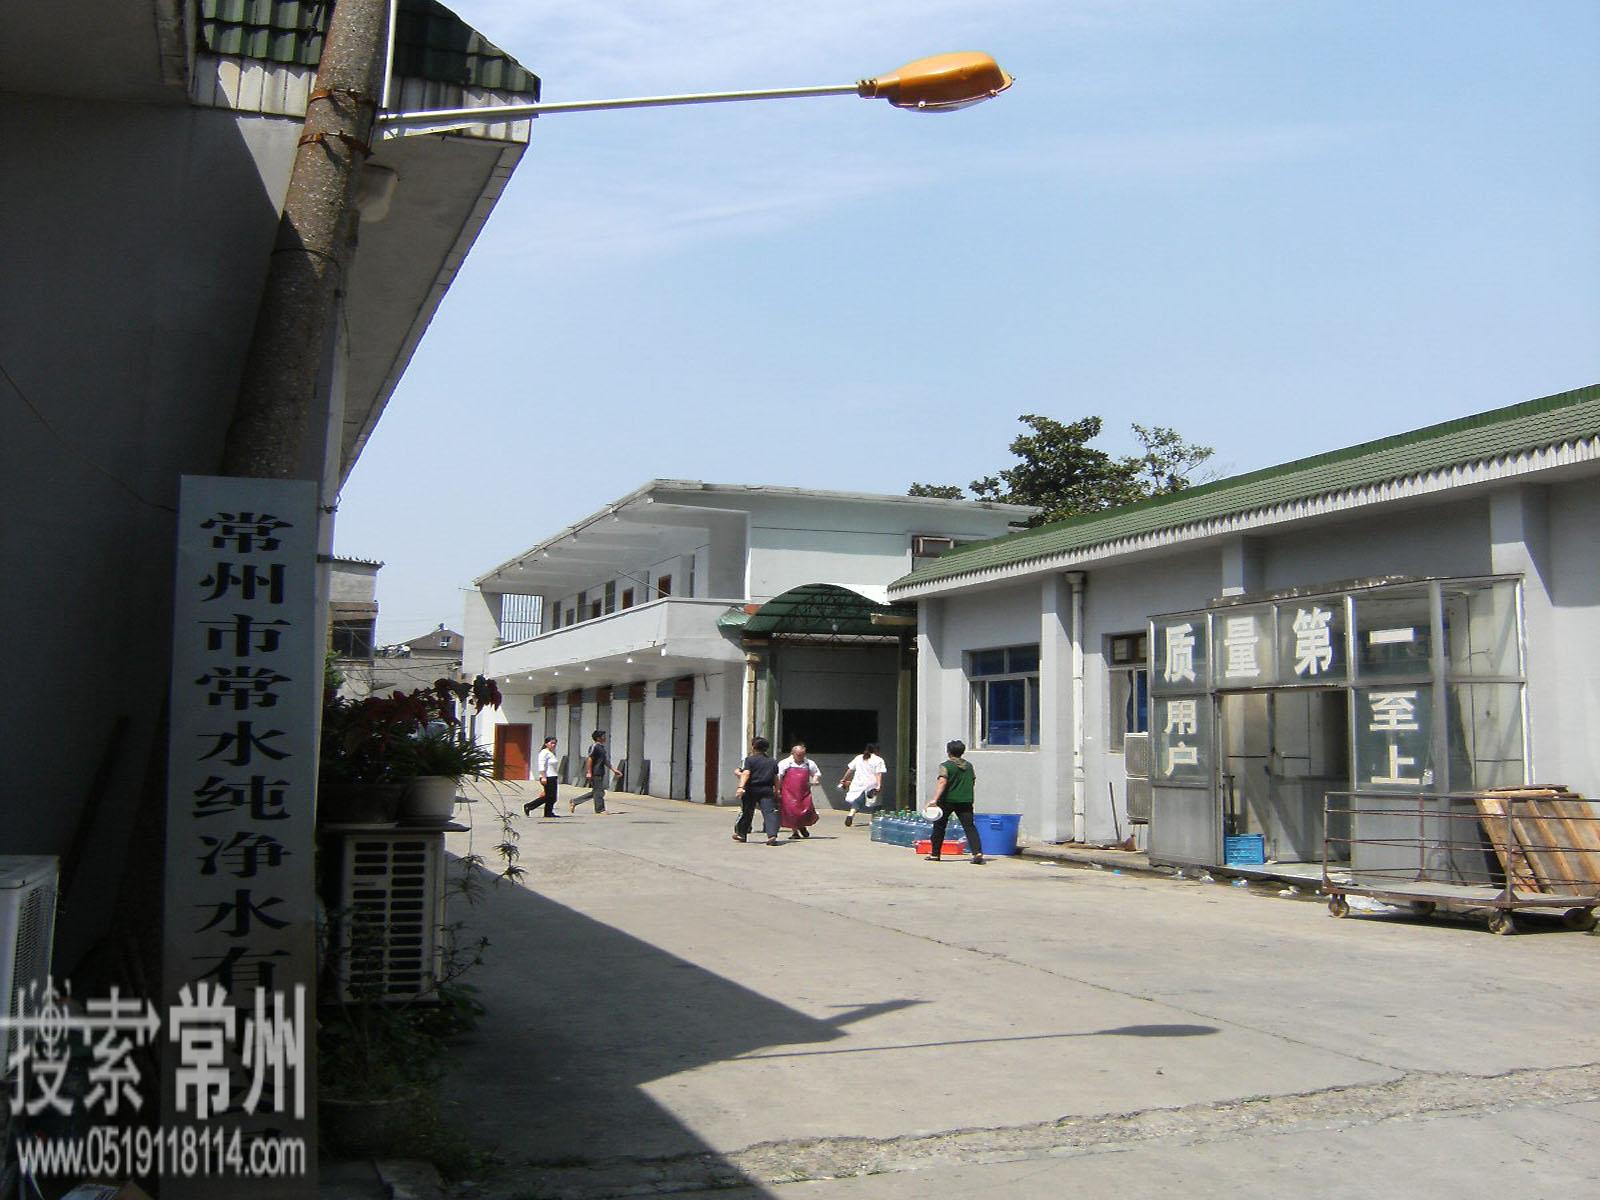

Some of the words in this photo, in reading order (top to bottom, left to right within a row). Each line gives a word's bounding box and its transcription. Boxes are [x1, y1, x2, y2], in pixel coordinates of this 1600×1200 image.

[1164, 606, 1414, 682] 质量第一
[191, 512, 293, 1172] 常州市常水纯净水有
